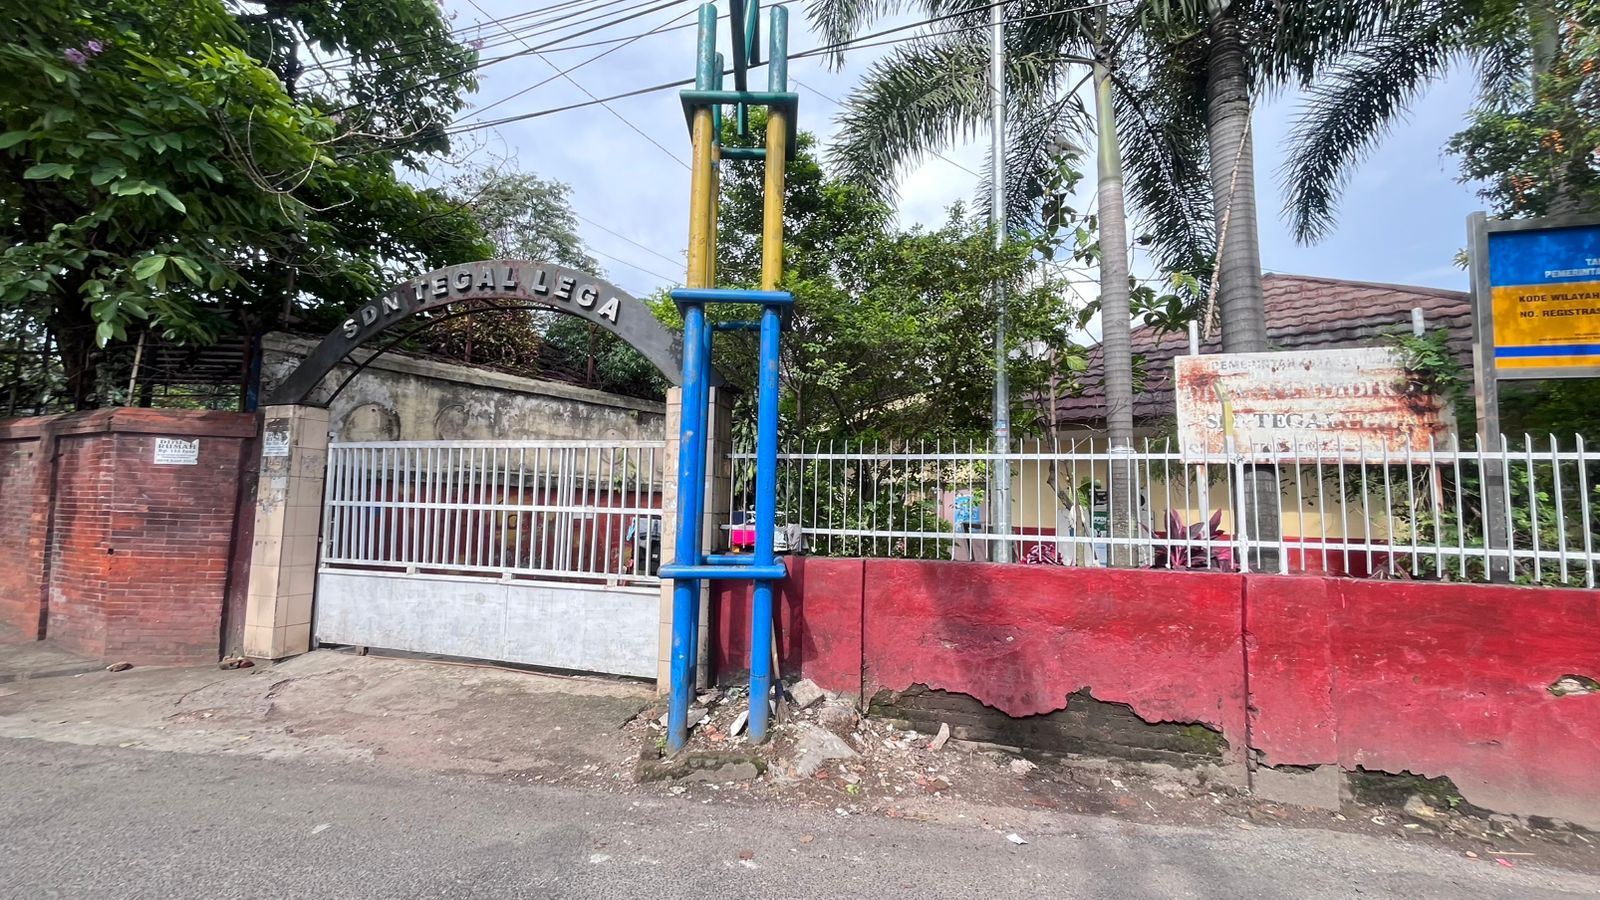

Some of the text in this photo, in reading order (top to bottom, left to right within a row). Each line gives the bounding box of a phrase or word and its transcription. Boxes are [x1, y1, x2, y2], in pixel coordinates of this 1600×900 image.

[342, 267, 622, 339] SDN TEGAL LEGA
[1550, 292, 1600, 301] WILAYAH
